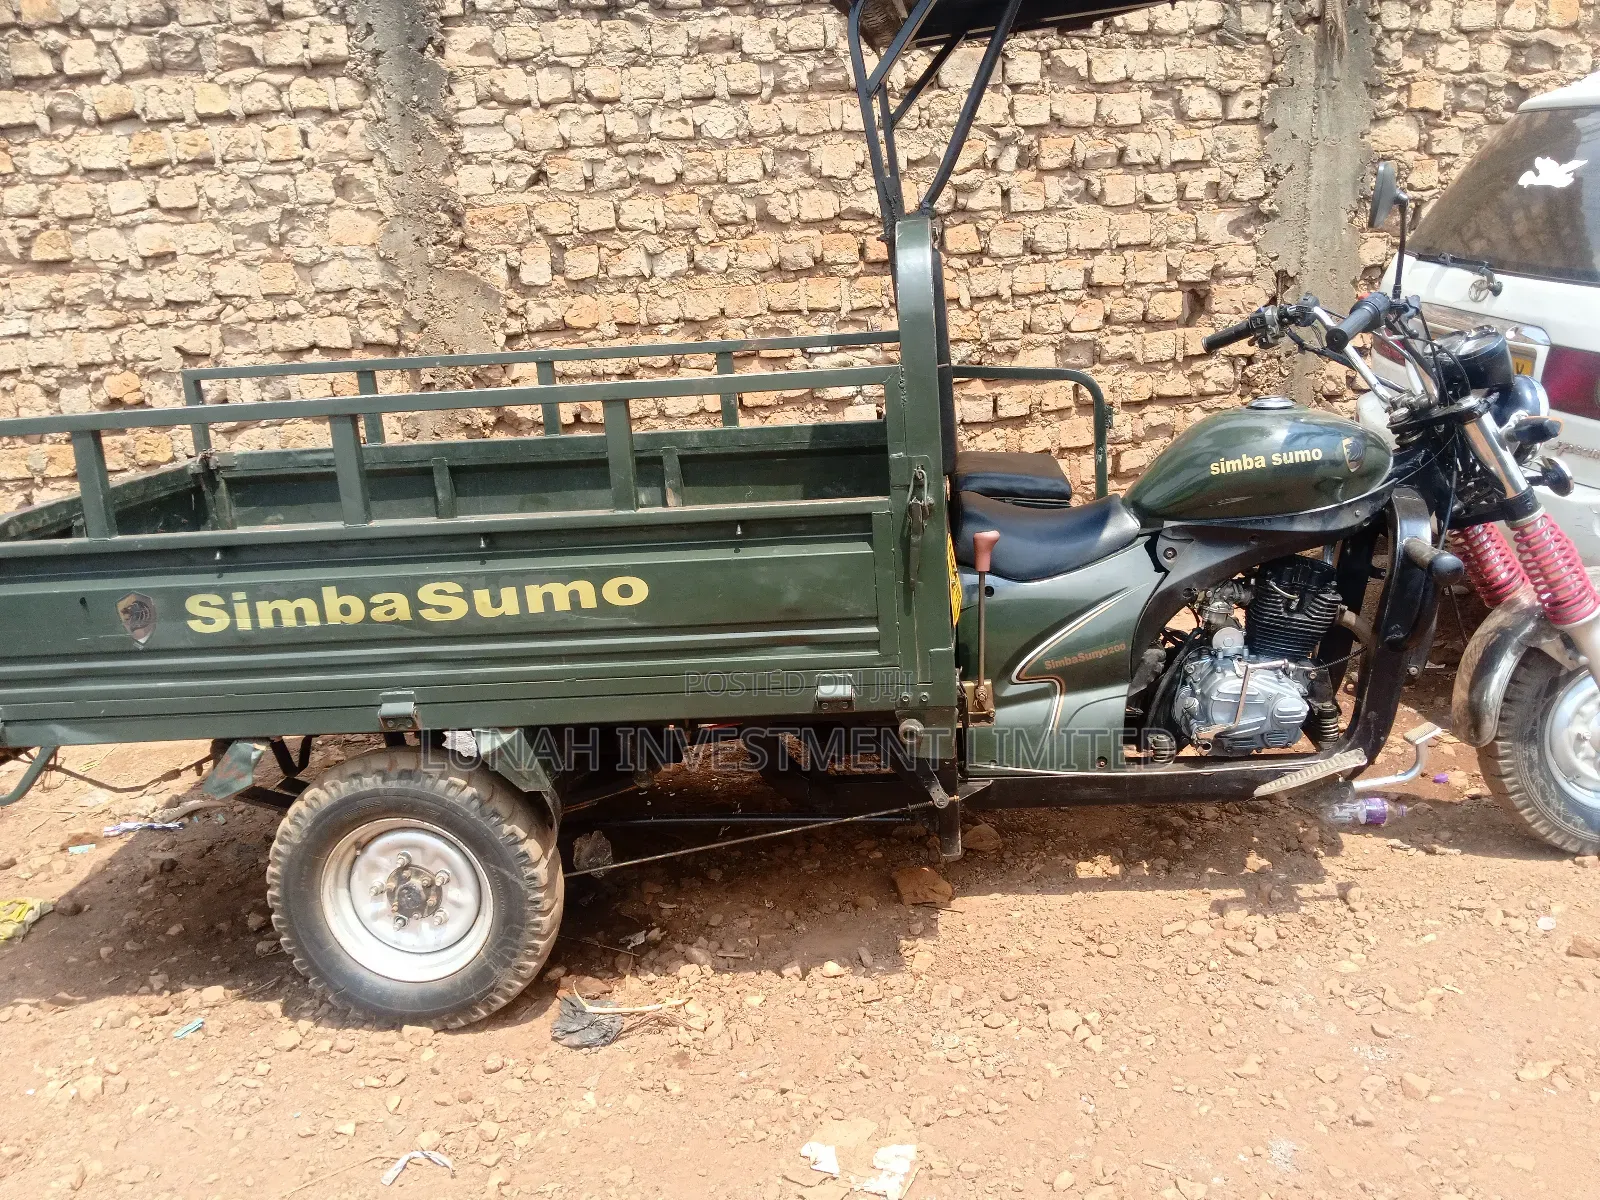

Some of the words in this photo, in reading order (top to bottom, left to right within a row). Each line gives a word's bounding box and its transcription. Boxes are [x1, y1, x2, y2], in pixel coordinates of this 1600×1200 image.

[1209, 453, 1267, 476] simba
[1271, 447, 1323, 467] sumo
[185, 575, 650, 634] SimbaSumo
